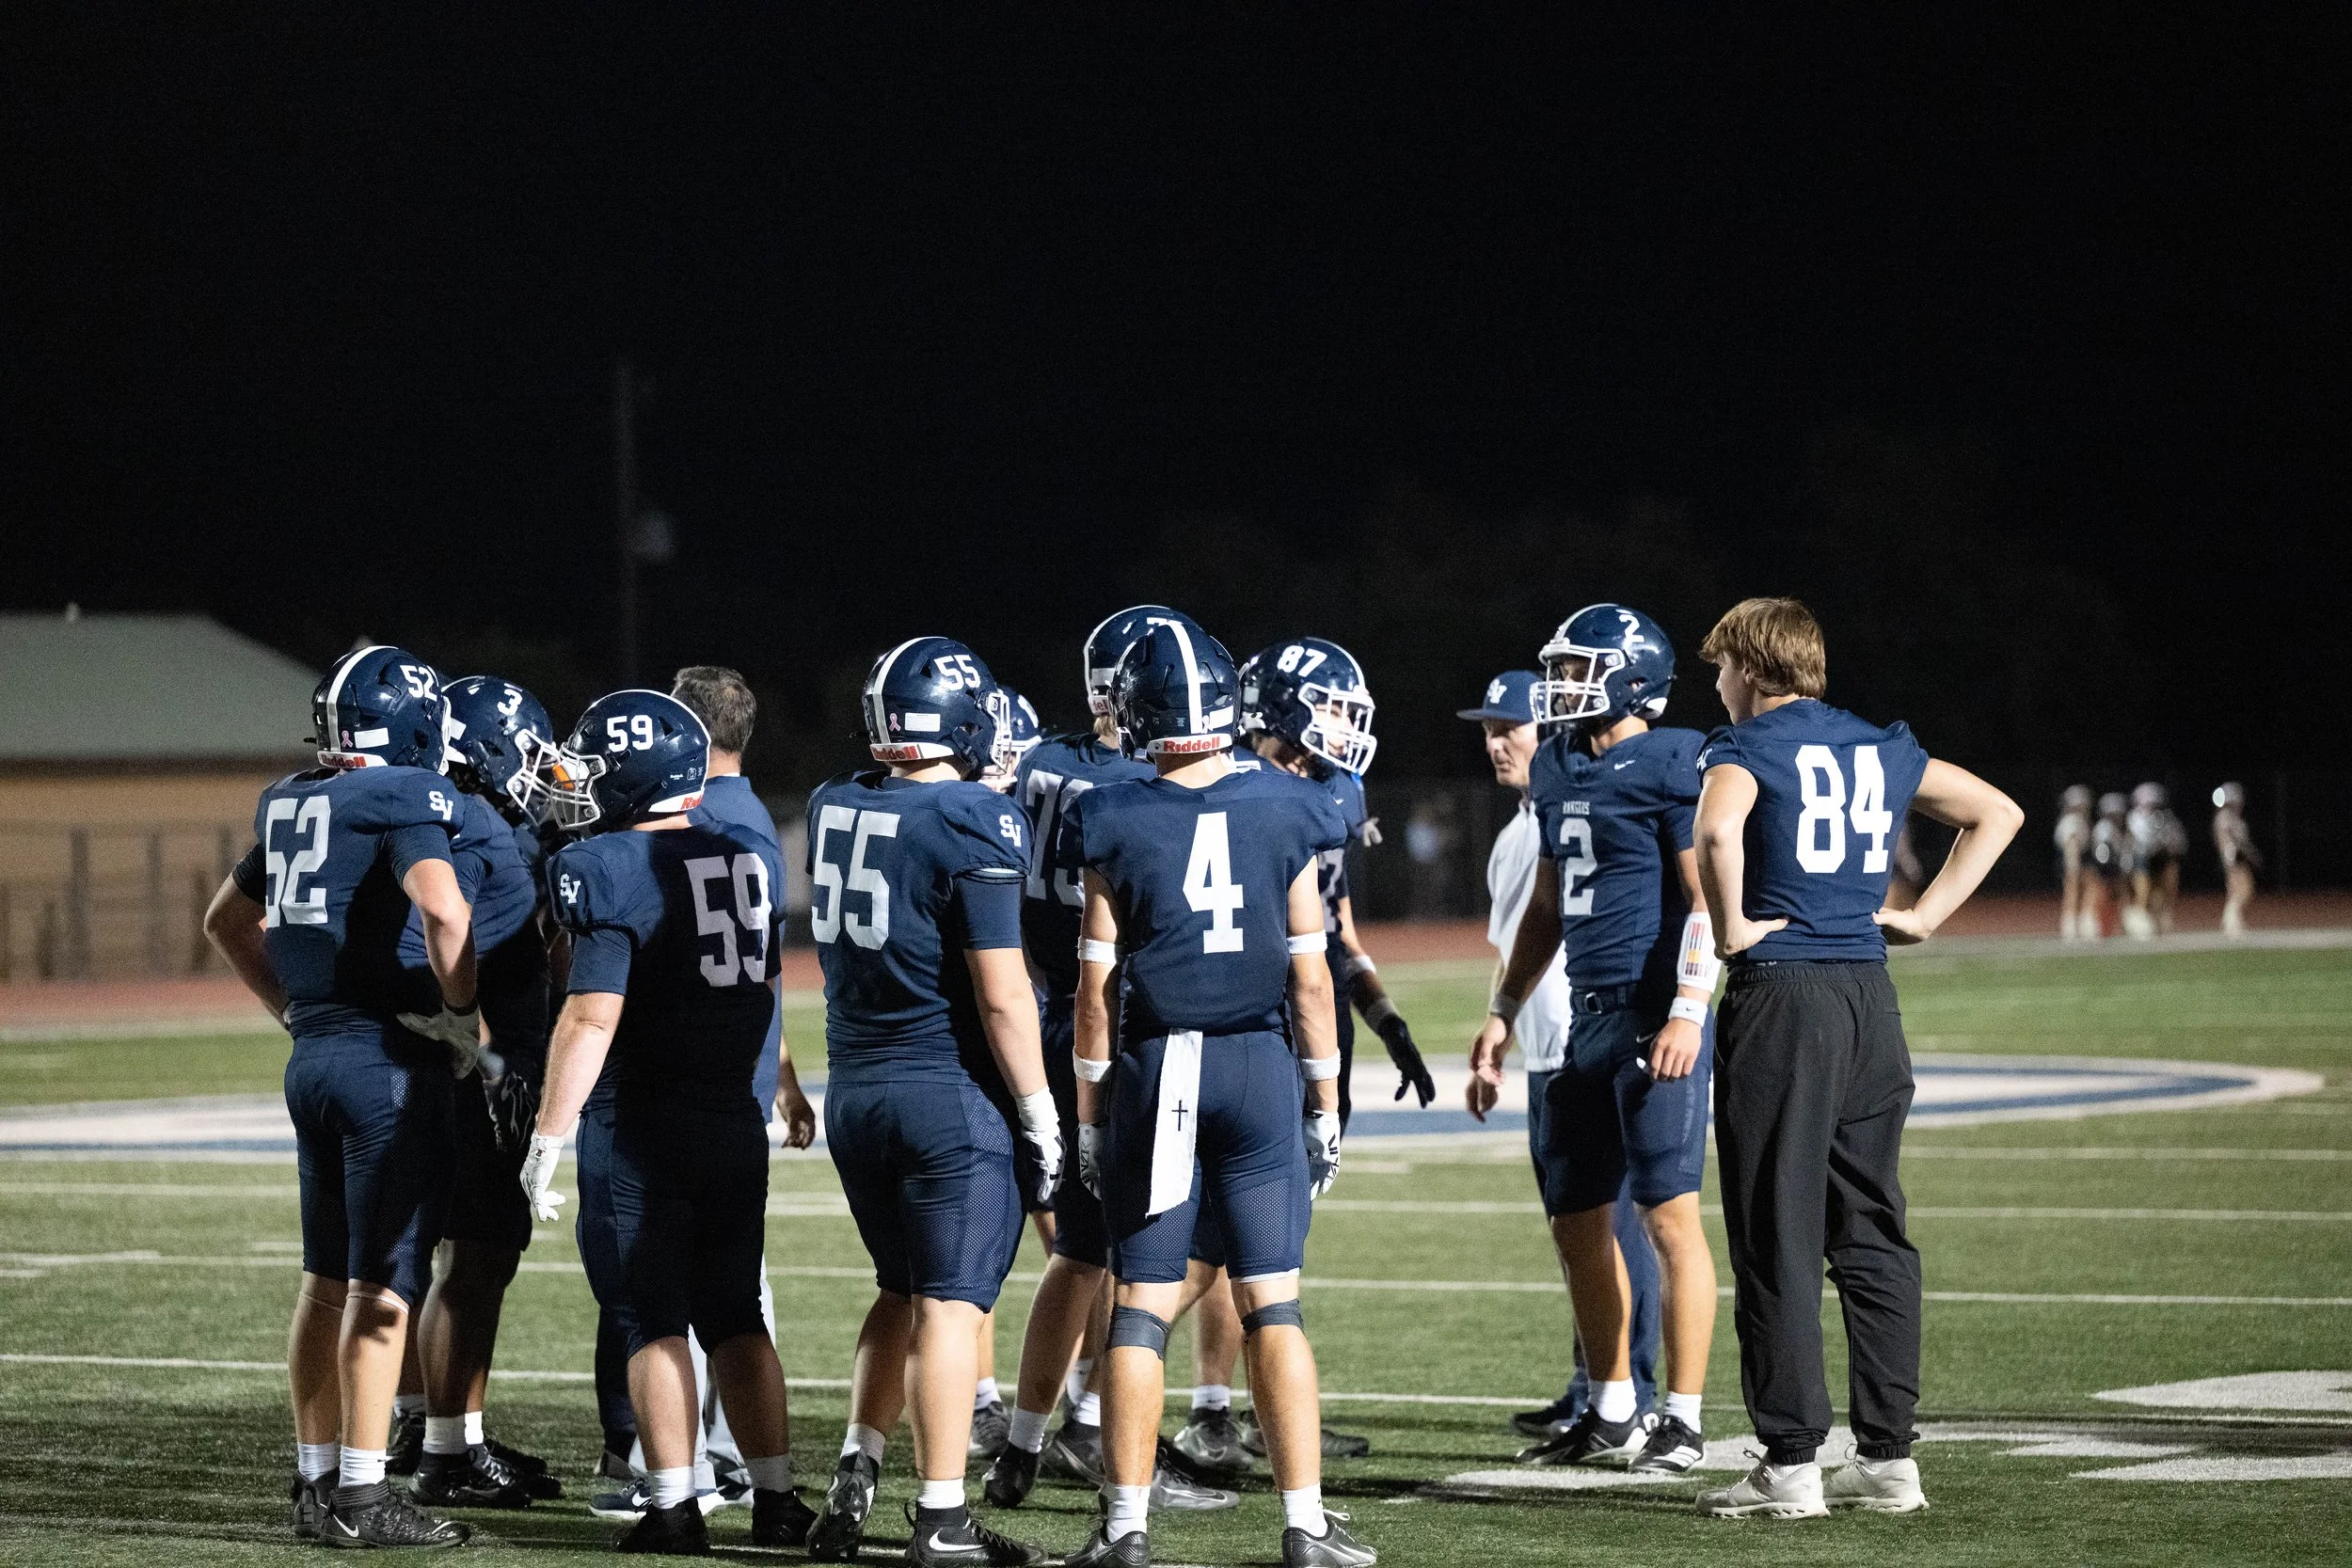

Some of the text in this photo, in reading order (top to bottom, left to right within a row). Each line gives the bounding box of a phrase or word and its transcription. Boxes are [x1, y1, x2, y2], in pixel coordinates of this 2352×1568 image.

[1619, 614, 1645, 646] 2
[934, 655, 980, 690] 55
[1277, 645, 1327, 676] 87
[399, 665, 438, 702] 52
[497, 689, 523, 716] 3
[607, 714, 653, 752] 59
[1163, 736, 1220, 752] Riddell
[428, 791, 453, 821] SV
[1794, 745, 1893, 874] 84
[999, 815, 1022, 847] SV
[265, 795, 331, 927] 52
[812, 805, 900, 950] 55
[1560, 817, 1597, 915] 2
[560, 874, 581, 904] SV
[1184, 812, 1244, 954] 4
[683, 852, 772, 988] 59
